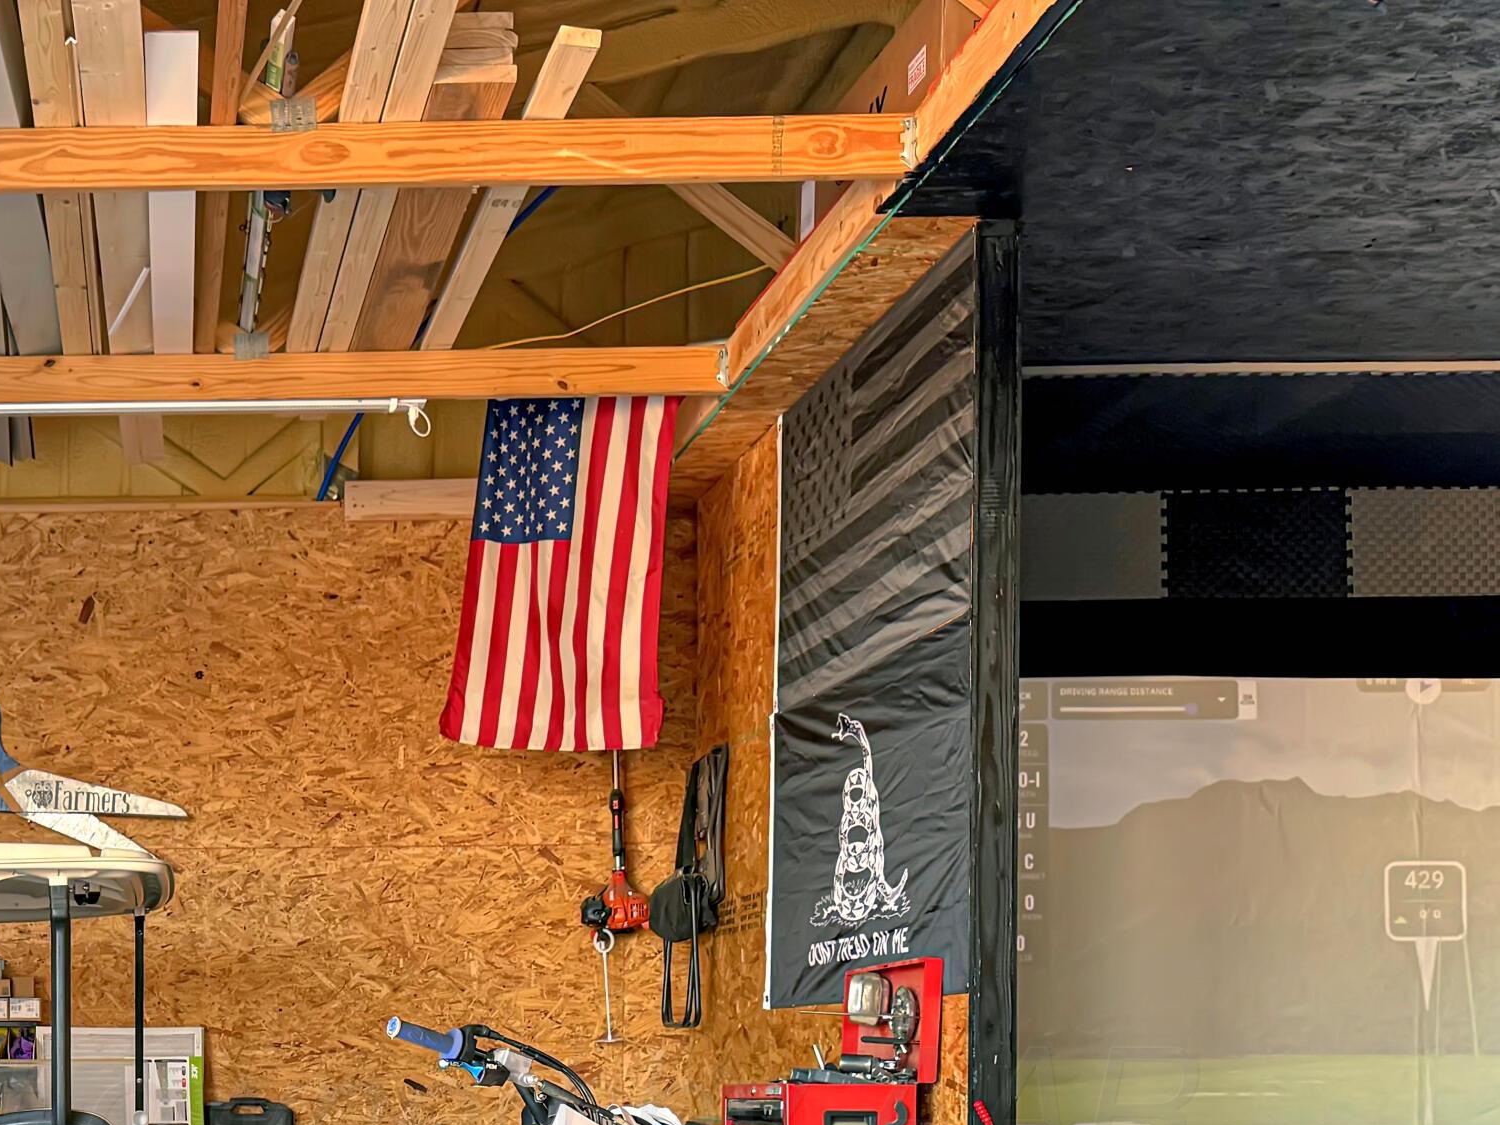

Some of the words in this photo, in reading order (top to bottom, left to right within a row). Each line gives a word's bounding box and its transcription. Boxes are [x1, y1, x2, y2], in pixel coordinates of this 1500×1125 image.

[1059, 688, 1097, 696] DRIVING
[1099, 688, 1129, 696] RANGE
[1130, 688, 1174, 696] DISTANCE
[54, 779, 131, 814] Farmers
[1404, 870, 1445, 889] 429
[837, 933, 871, 962] TREAD
[873, 931, 890, 956] ON
[892, 927, 910, 954] ME
